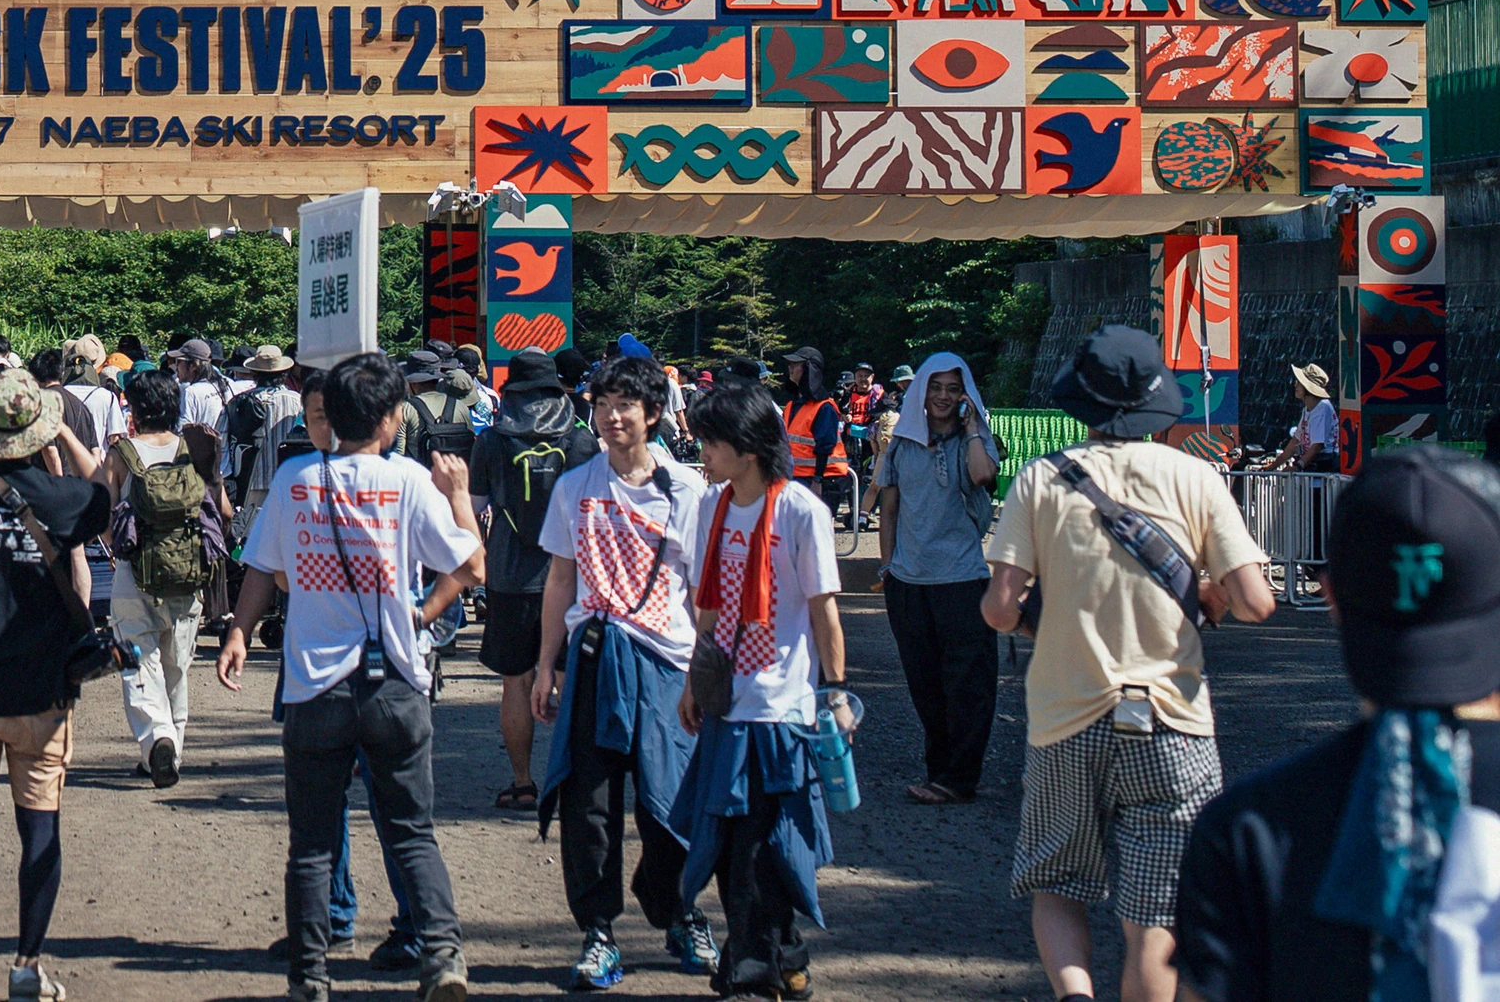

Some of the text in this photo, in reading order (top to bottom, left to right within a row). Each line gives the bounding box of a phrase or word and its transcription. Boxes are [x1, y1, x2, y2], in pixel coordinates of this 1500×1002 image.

[43, 116, 191, 146] NAEBA
[193, 115, 263, 145] SKI
[270, 115, 446, 146] RESORT
[310, 273, 349, 320] 最後尾
